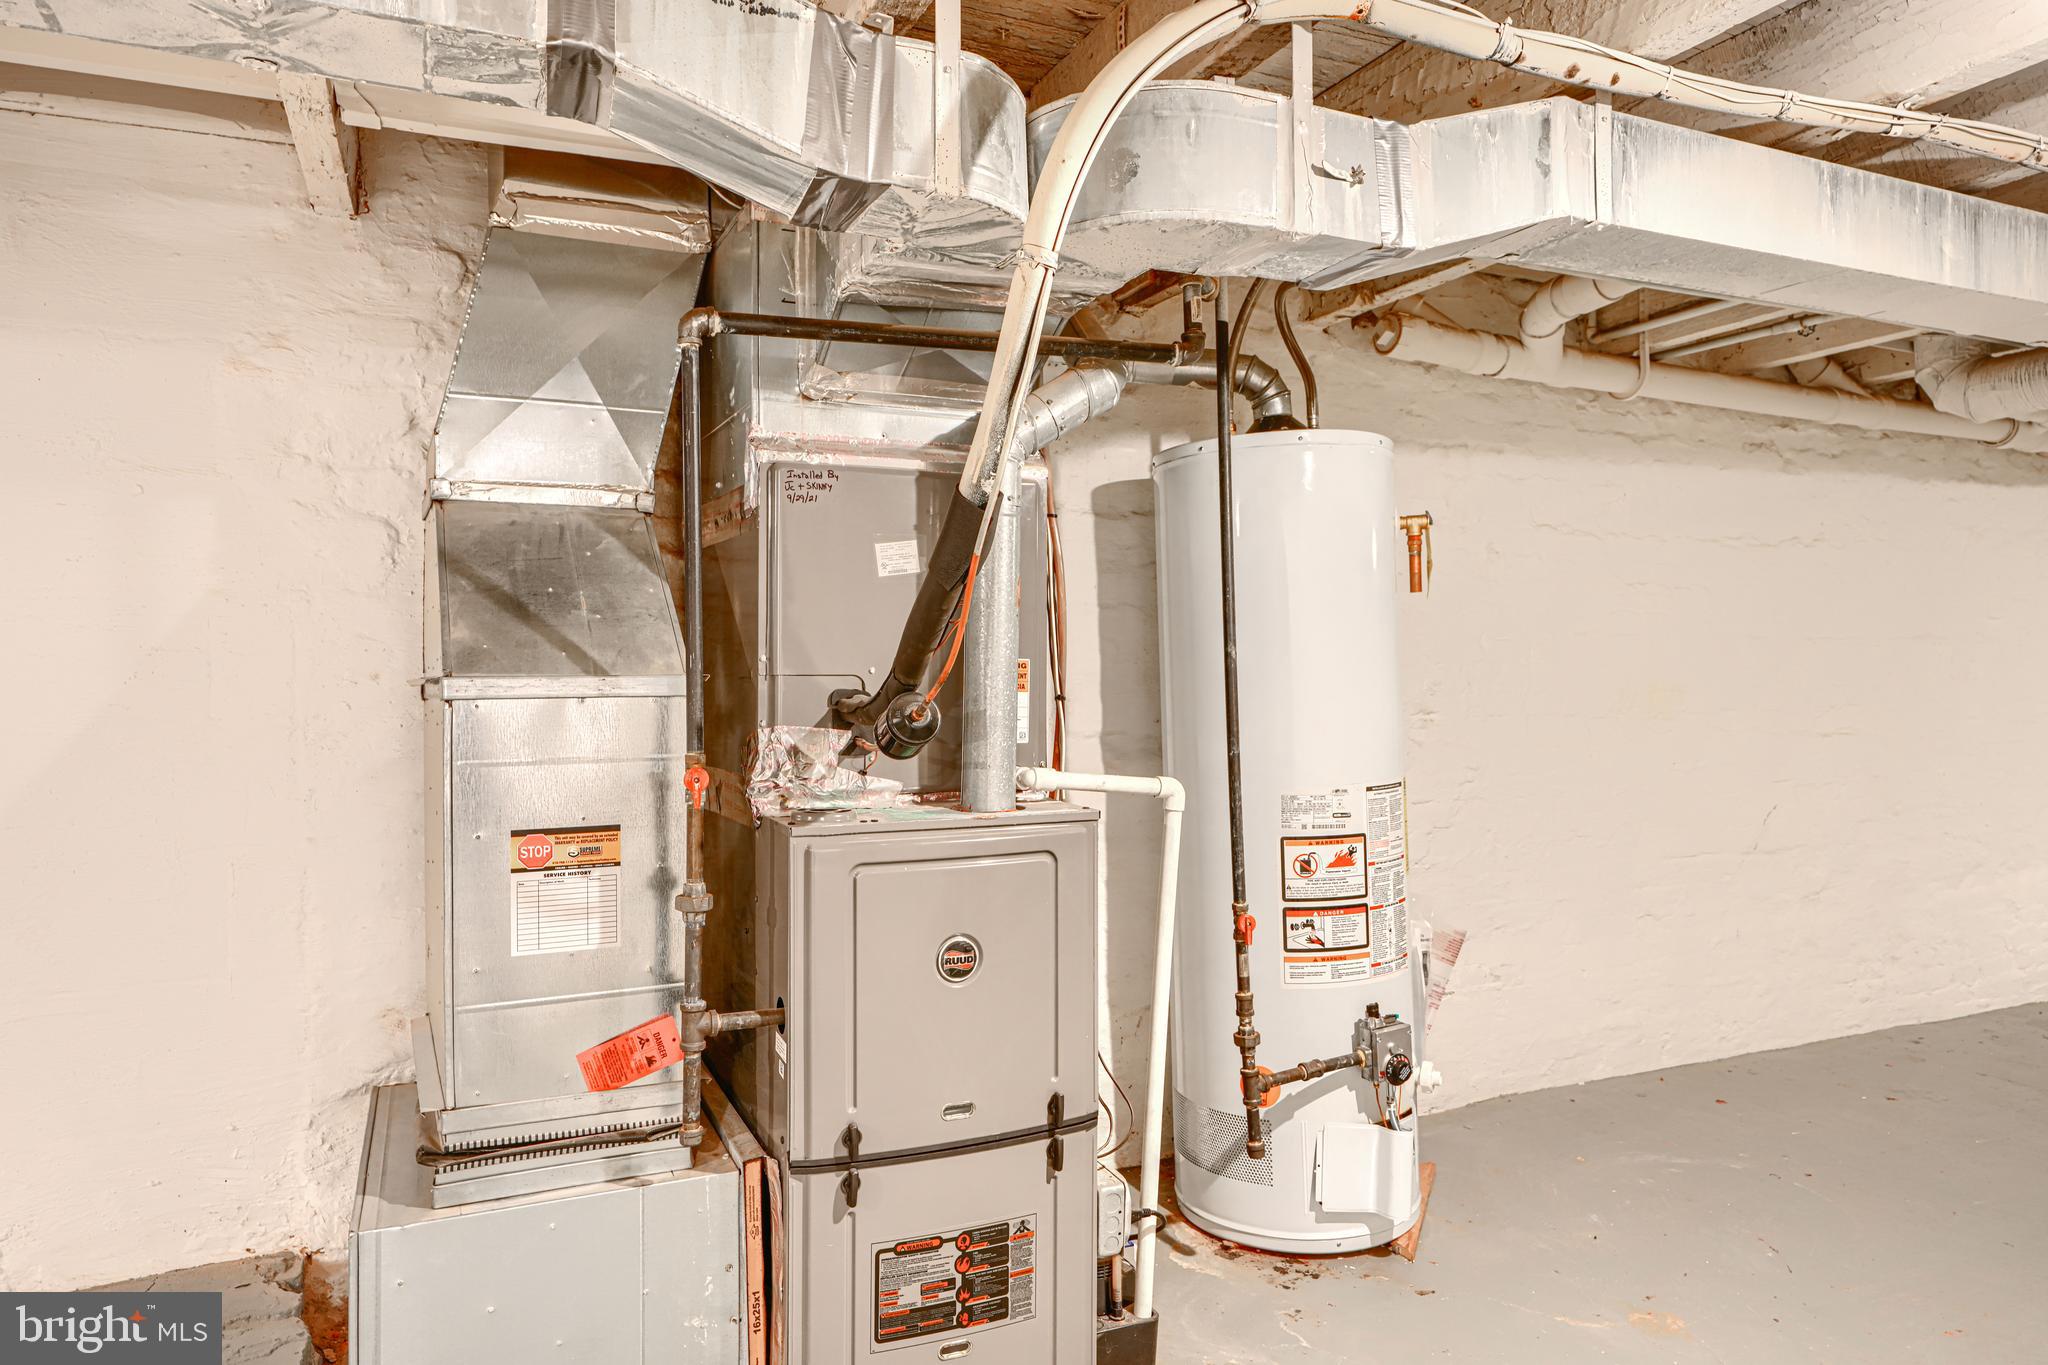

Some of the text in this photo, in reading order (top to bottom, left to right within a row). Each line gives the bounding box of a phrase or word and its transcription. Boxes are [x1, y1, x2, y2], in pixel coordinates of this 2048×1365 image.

[786, 469, 839, 481] Installed By
[786, 491, 818, 504] 9/29/21
[520, 845, 551, 859] STOP
[1320, 909, 1344, 917] DANGER
[944, 955, 974, 966] RUUD
[653, 1032, 668, 1059] DANGER
[906, 1241, 934, 1251] WARNING
[752, 1290, 761, 1334] 16x25x1
